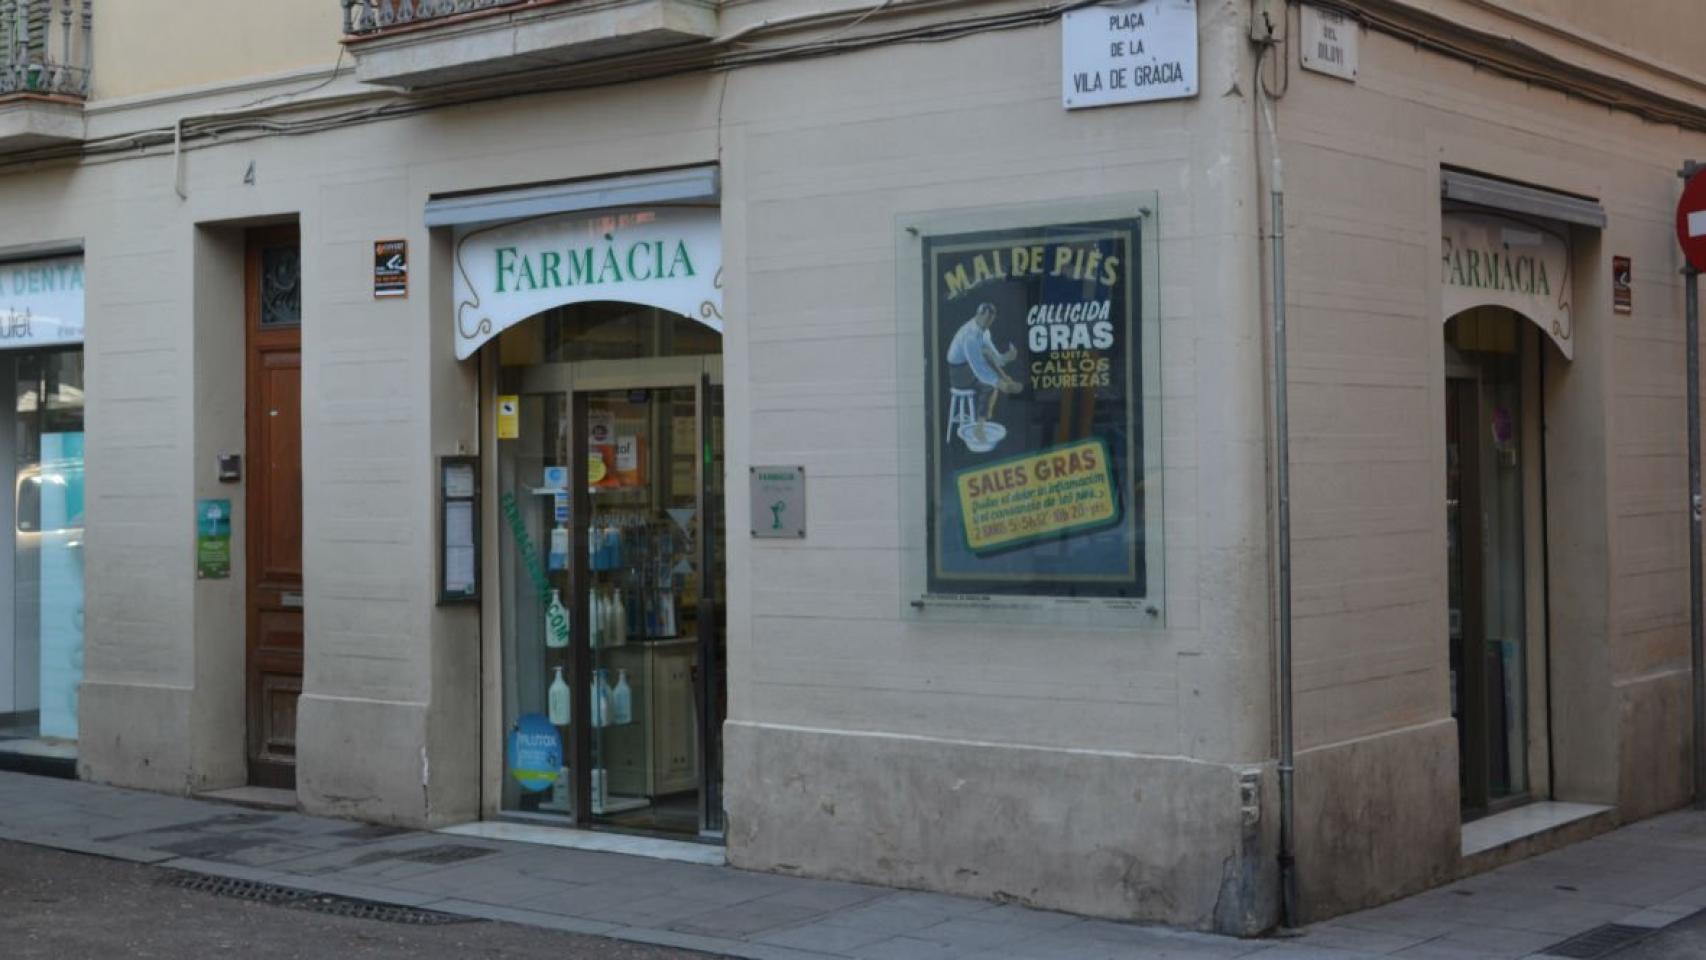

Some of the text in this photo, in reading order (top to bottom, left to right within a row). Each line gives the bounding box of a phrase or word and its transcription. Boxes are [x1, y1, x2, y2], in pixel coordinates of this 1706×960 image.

[1109, 12, 1145, 32] PLAÇA
[1110, 39, 1145, 57] DE LA
[1073, 57, 1184, 93] VILA DE GRÀCIA
[243, 159, 256, 186] 4
[494, 233, 696, 294] FARMÀCIA
[944, 249, 1007, 300] MAL
[1011, 246, 1045, 277] DE
[1027, 301, 1111, 326] CALLICIDA
[1028, 321, 1114, 353] GRAS
[1031, 357, 1110, 374] CALLOS
[1050, 350, 1090, 360] QUITA
[968, 450, 1096, 497] SALES GRAS
